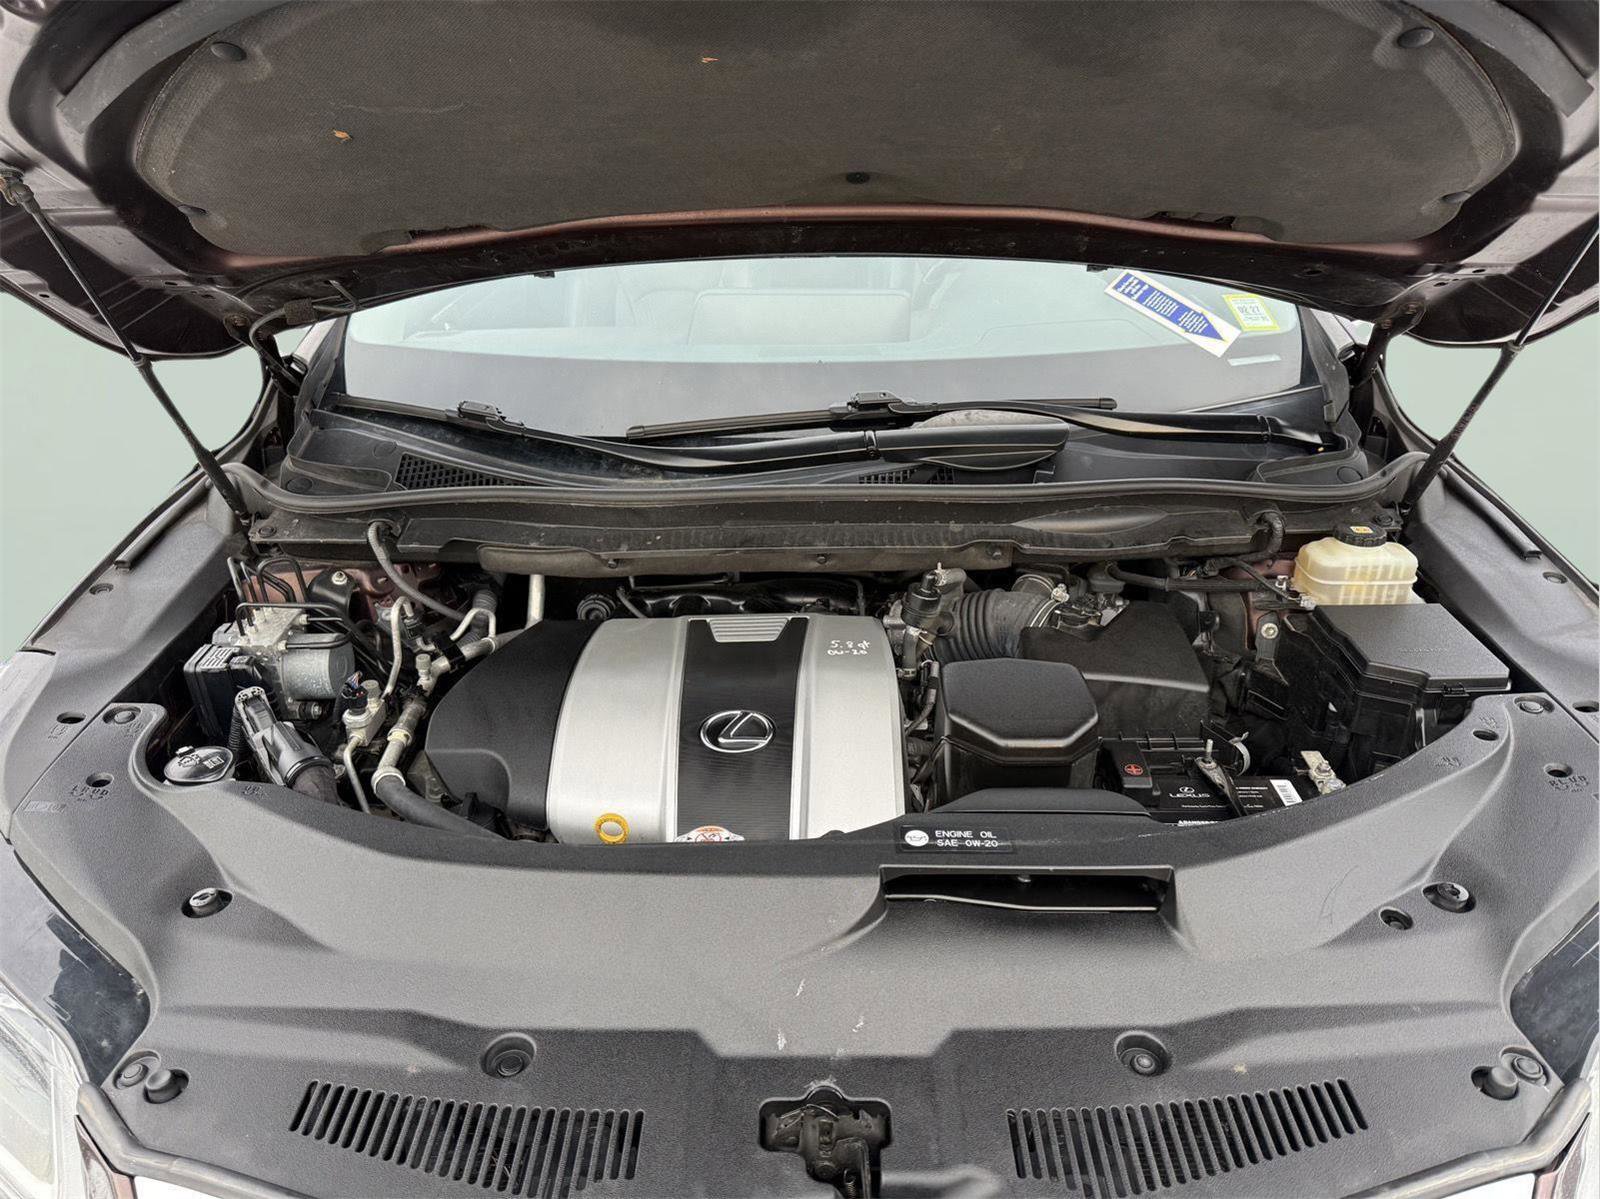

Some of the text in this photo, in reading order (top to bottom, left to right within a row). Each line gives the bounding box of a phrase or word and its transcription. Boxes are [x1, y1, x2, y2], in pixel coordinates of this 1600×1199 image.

[934, 829, 998, 839] ENGINE OIL
[936, 839, 999, 848] SAE 0W-20
